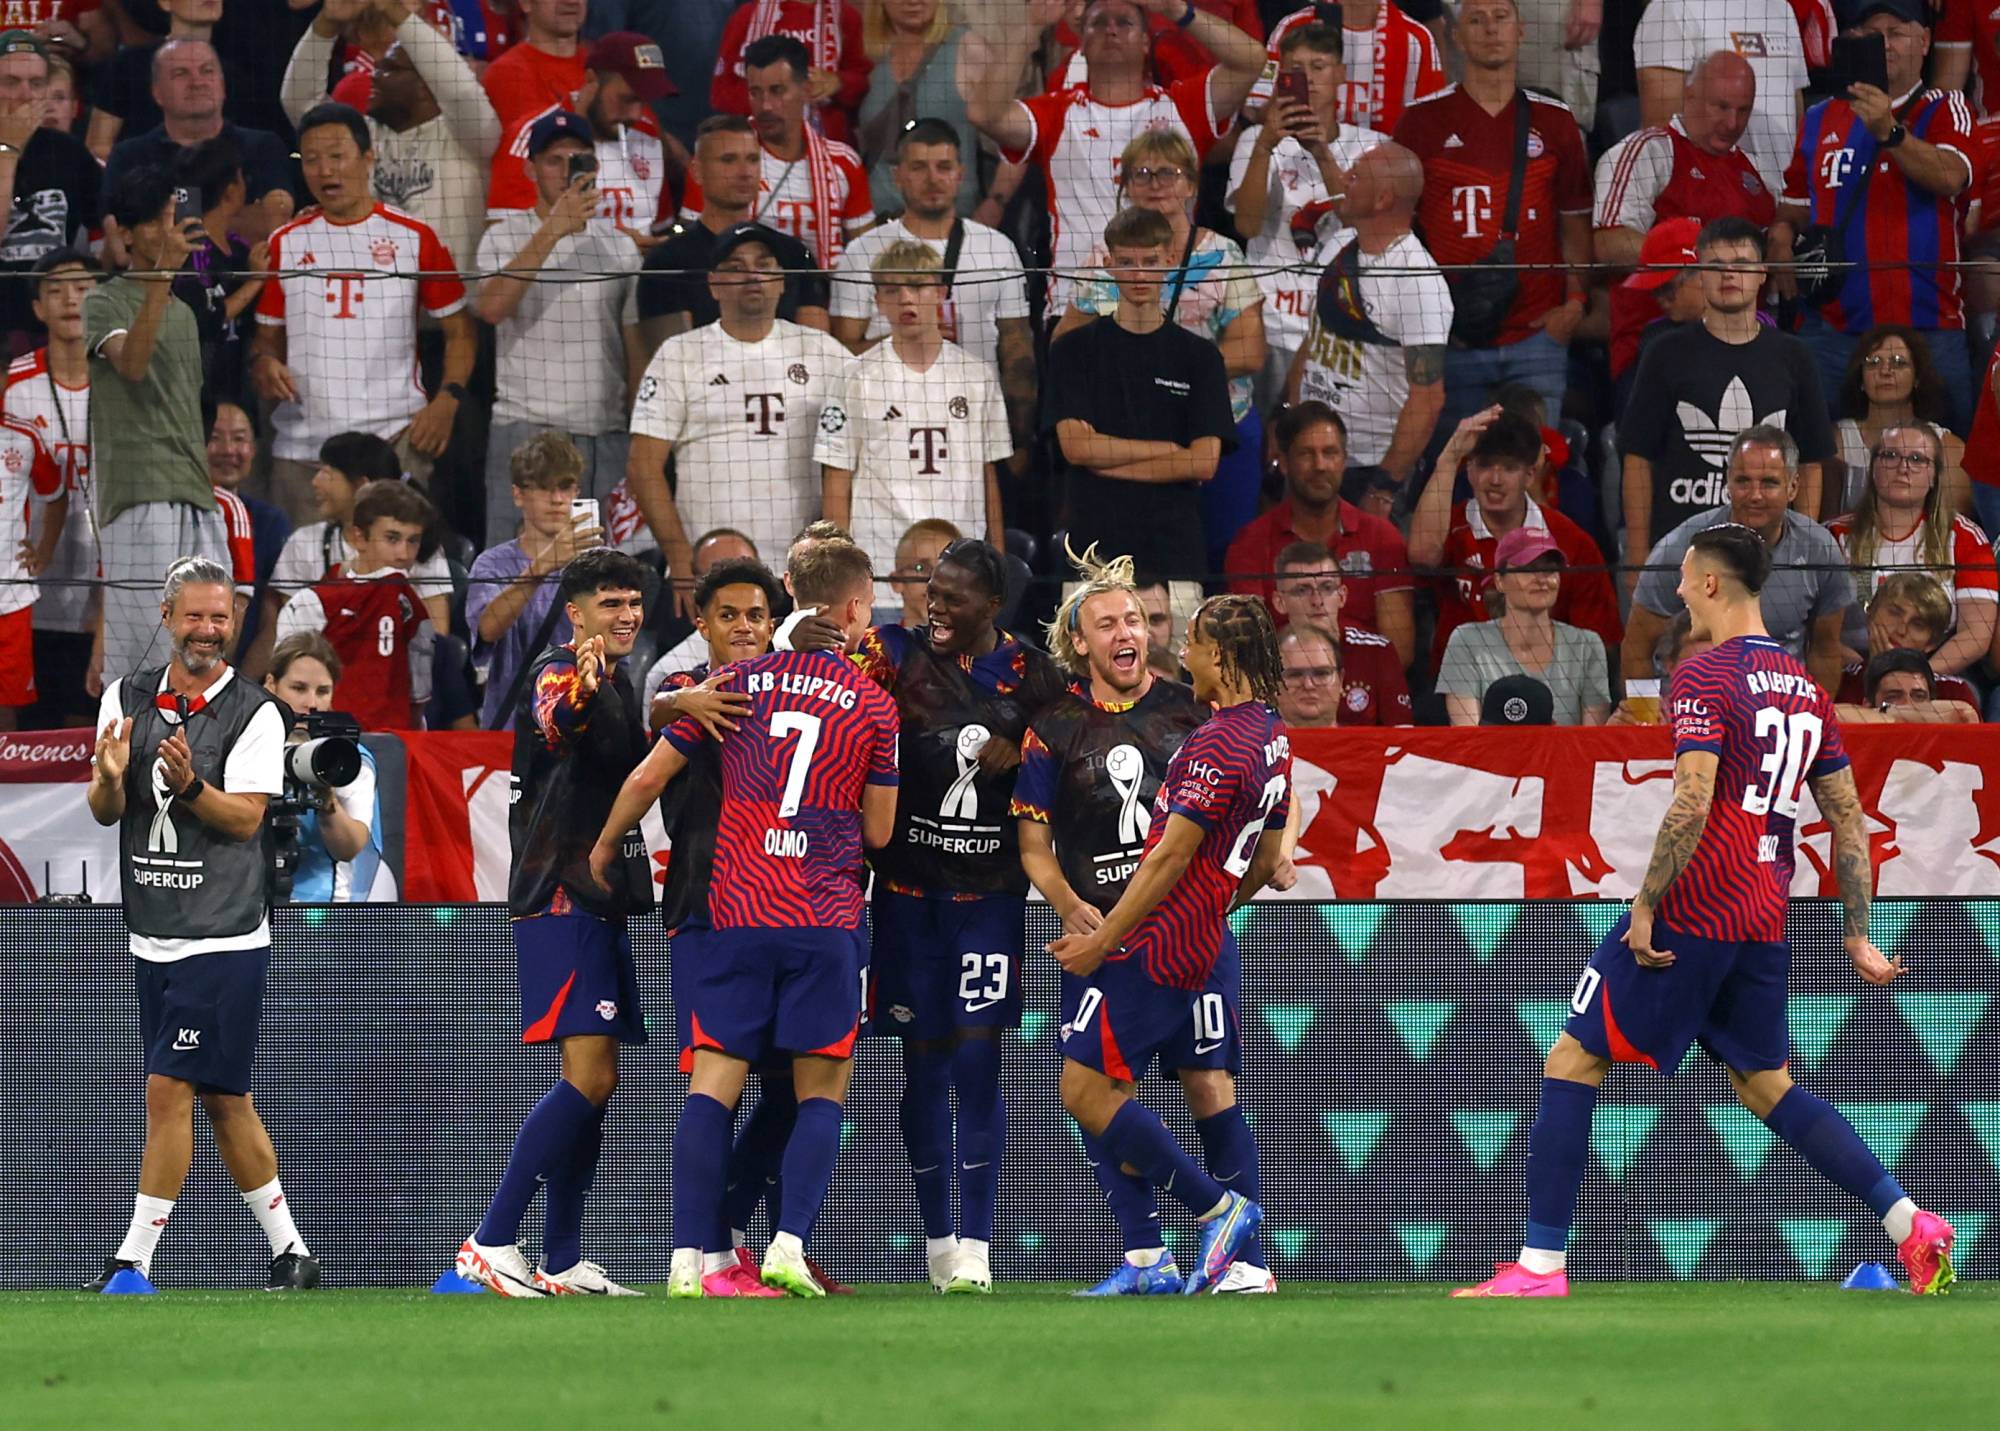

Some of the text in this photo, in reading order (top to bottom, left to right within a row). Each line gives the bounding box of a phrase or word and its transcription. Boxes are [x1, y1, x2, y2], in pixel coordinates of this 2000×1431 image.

[745, 393, 785, 435] T
[909, 427, 948, 475] T
[1670, 472, 1732, 505] adi
[378, 616, 394, 657] 8
[748, 672, 857, 710] RB LEIPZIG
[769, 710, 822, 818] 7
[1188, 759, 1225, 786] IHG
[1741, 706, 1823, 819] 30
[764, 828, 808, 858] OLMO
[908, 827, 1001, 854] SUPERCUP
[134, 868, 204, 889] SUPERCUP
[958, 952, 1009, 1000] 23
[1192, 992, 1225, 1040] 10
[178, 1028, 201, 1045] KK
